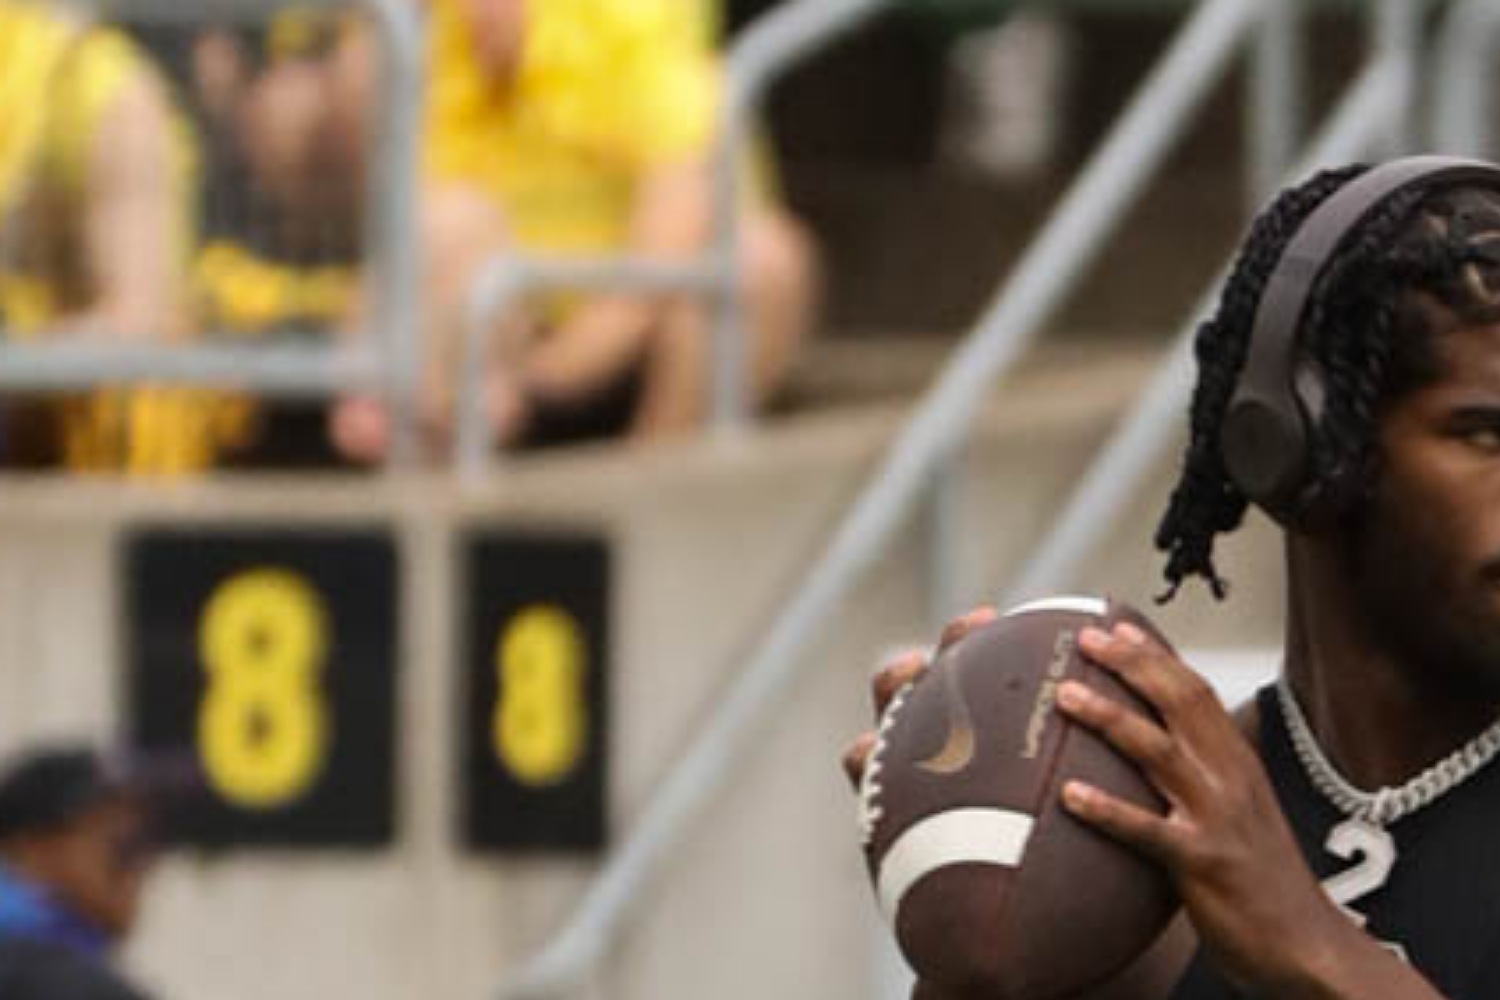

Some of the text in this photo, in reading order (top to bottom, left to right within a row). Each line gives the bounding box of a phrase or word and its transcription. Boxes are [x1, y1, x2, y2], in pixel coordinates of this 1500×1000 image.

[200, 571, 324, 806] 8
[496, 607, 582, 781] 8
[1321, 819, 1397, 928] 2
